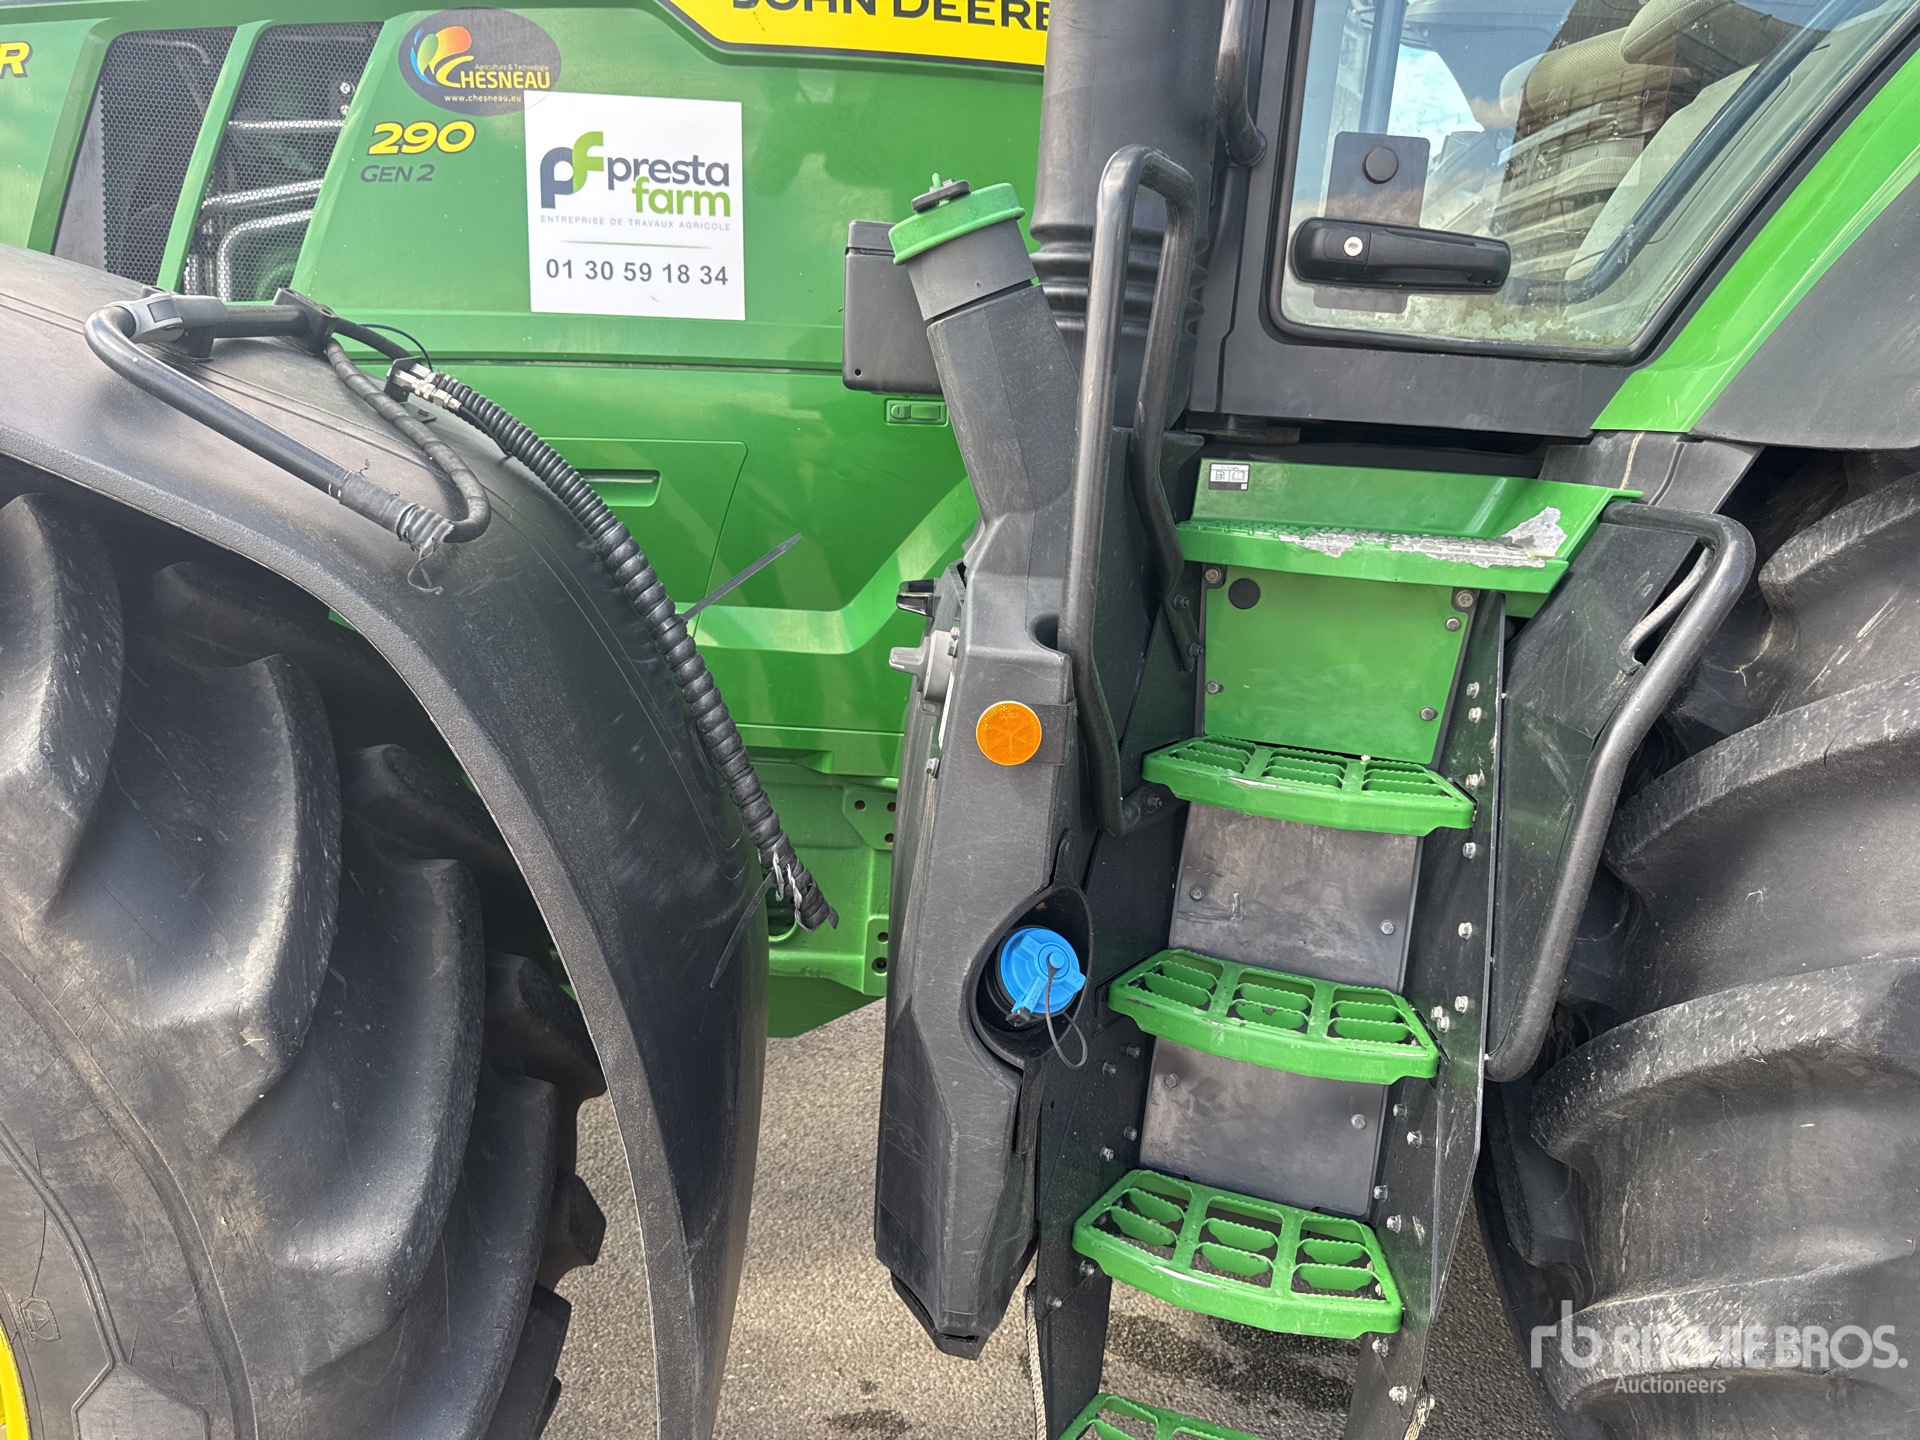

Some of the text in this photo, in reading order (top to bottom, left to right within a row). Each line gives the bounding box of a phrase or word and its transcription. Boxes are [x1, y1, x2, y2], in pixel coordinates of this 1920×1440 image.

[436, 55, 551, 89] CHESNEAU
[508, 63, 514, 71] &
[444, 94, 522, 102] www.chesneau.eu
[367, 118, 476, 155] 290
[360, 163, 436, 183] GEN 2
[607, 155, 730, 190] presta
[632, 176, 731, 217] farm
[540, 215, 731, 231] ENTREPRISE DE TRAVAUX AGRICOLE
[546, 258, 729, 286] 01 30 59 18 34
